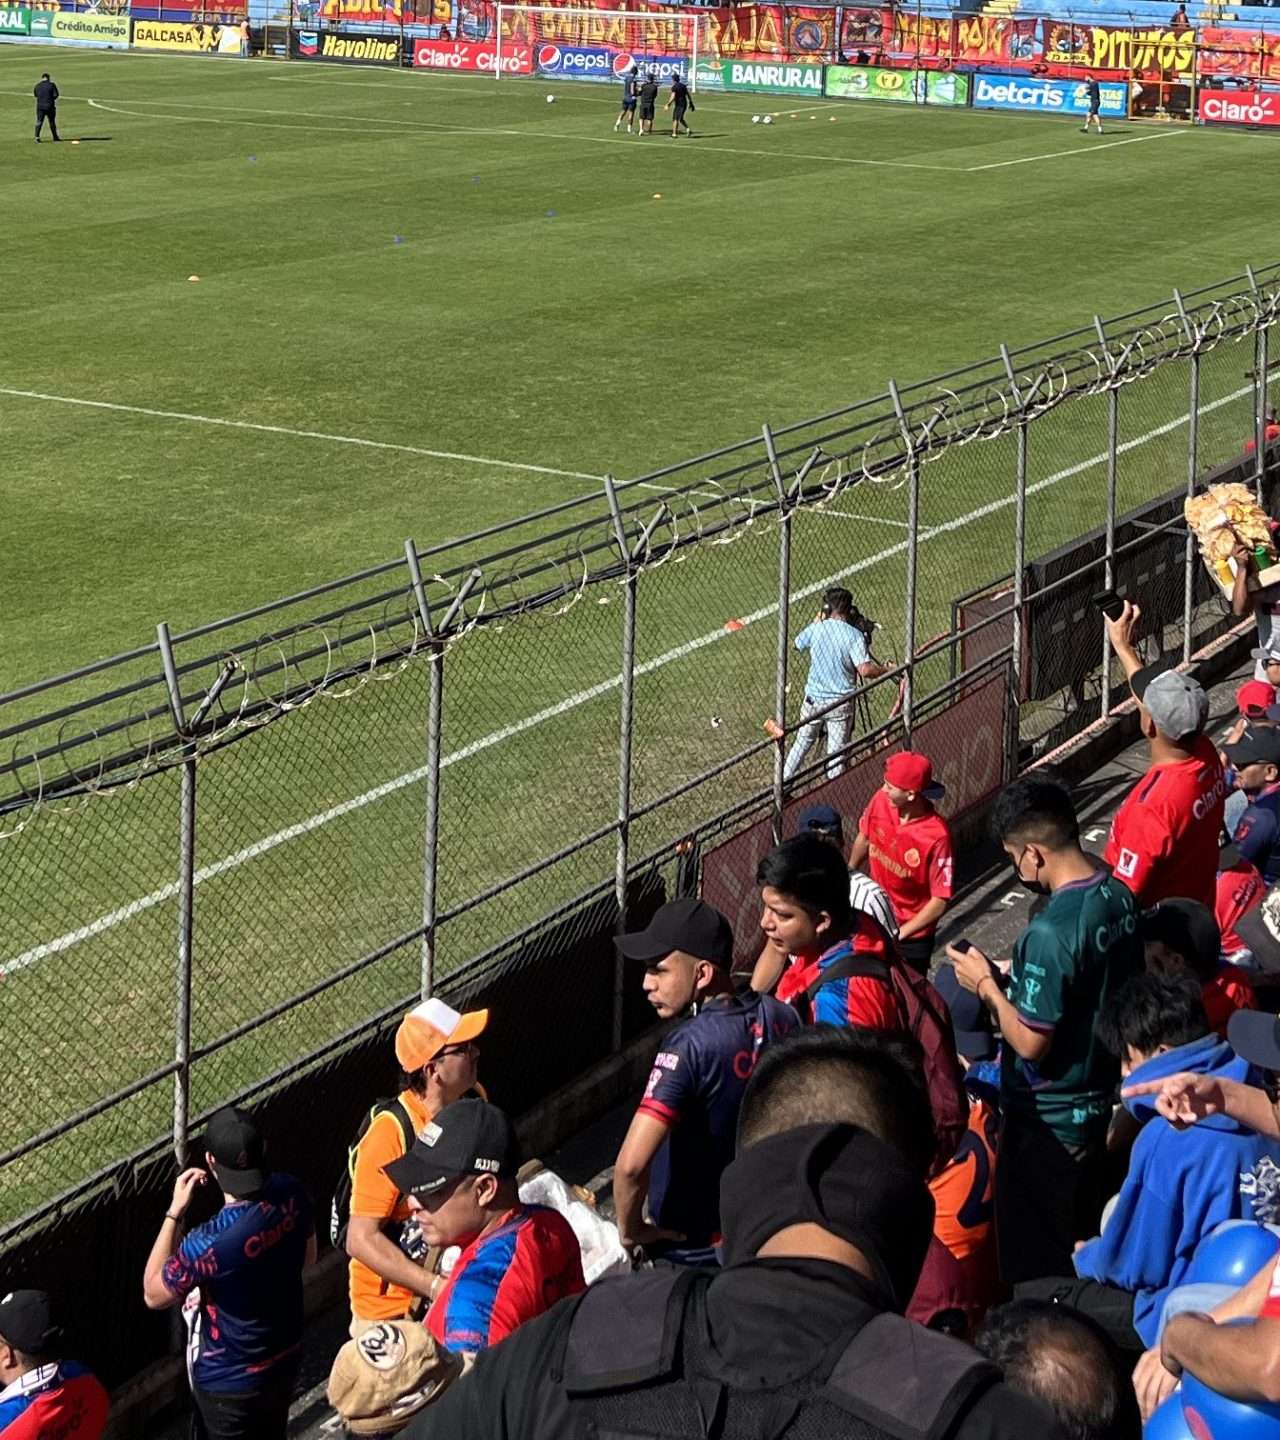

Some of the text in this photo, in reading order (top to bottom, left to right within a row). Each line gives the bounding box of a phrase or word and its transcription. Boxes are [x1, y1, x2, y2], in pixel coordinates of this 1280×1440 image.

[56, 20, 127, 37] Crédito Amigo
[136, 28, 193, 44] GALCASA
[322, 35, 399, 60] Havoline
[417, 47, 464, 67] Claro
[1091, 27, 1196, 71] PITUFOS
[563, 51, 610, 71] pepsi
[732, 64, 822, 89] BANRURAL
[977, 79, 1063, 107] betcris
[1204, 98, 1265, 121] Claro
[1192, 778, 1225, 820] Claro
